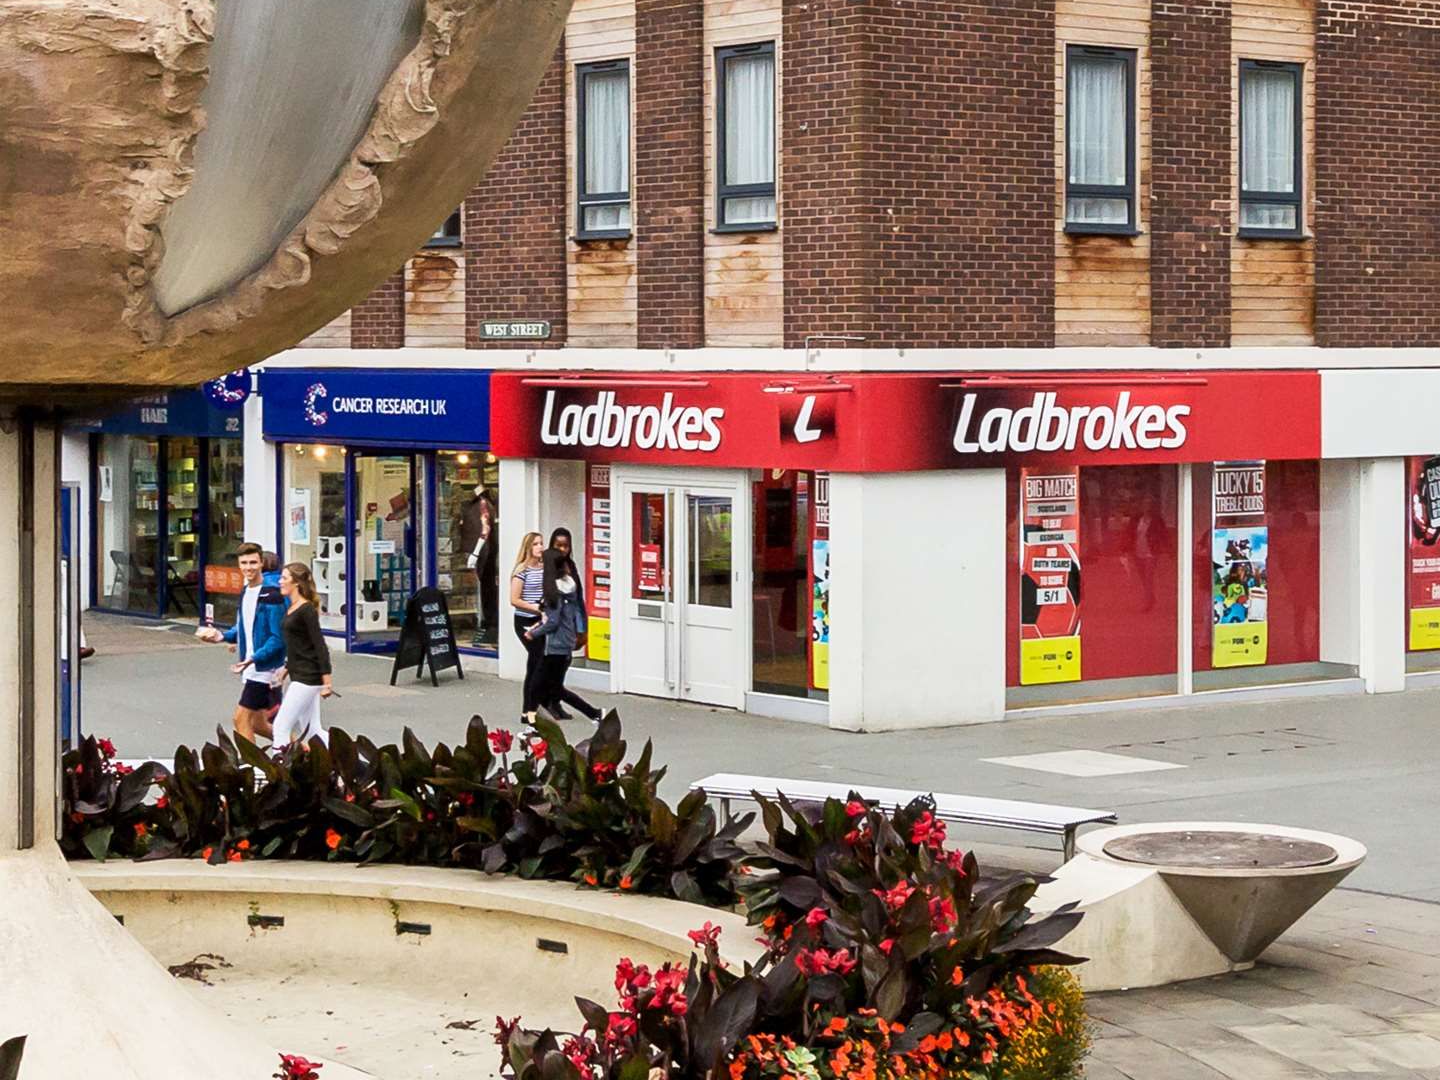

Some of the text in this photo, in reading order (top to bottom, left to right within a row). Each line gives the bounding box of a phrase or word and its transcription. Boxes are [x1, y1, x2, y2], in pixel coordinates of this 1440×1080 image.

[484, 323, 544, 336] WEST STREET
[332, 396, 447, 415] CANCER RESEARCH UK
[141, 407, 168, 424] HAIR
[540, 389, 725, 451] Ladbrokes
[952, 391, 1191, 453] Ladbrokes
[1026, 479, 1077, 498] BIG MATCH
[1215, 471, 1264, 494] LUCKY 15
[1216, 495, 1264, 512] TREBLE ODDS
[1044, 590, 1059, 603] 5/1
